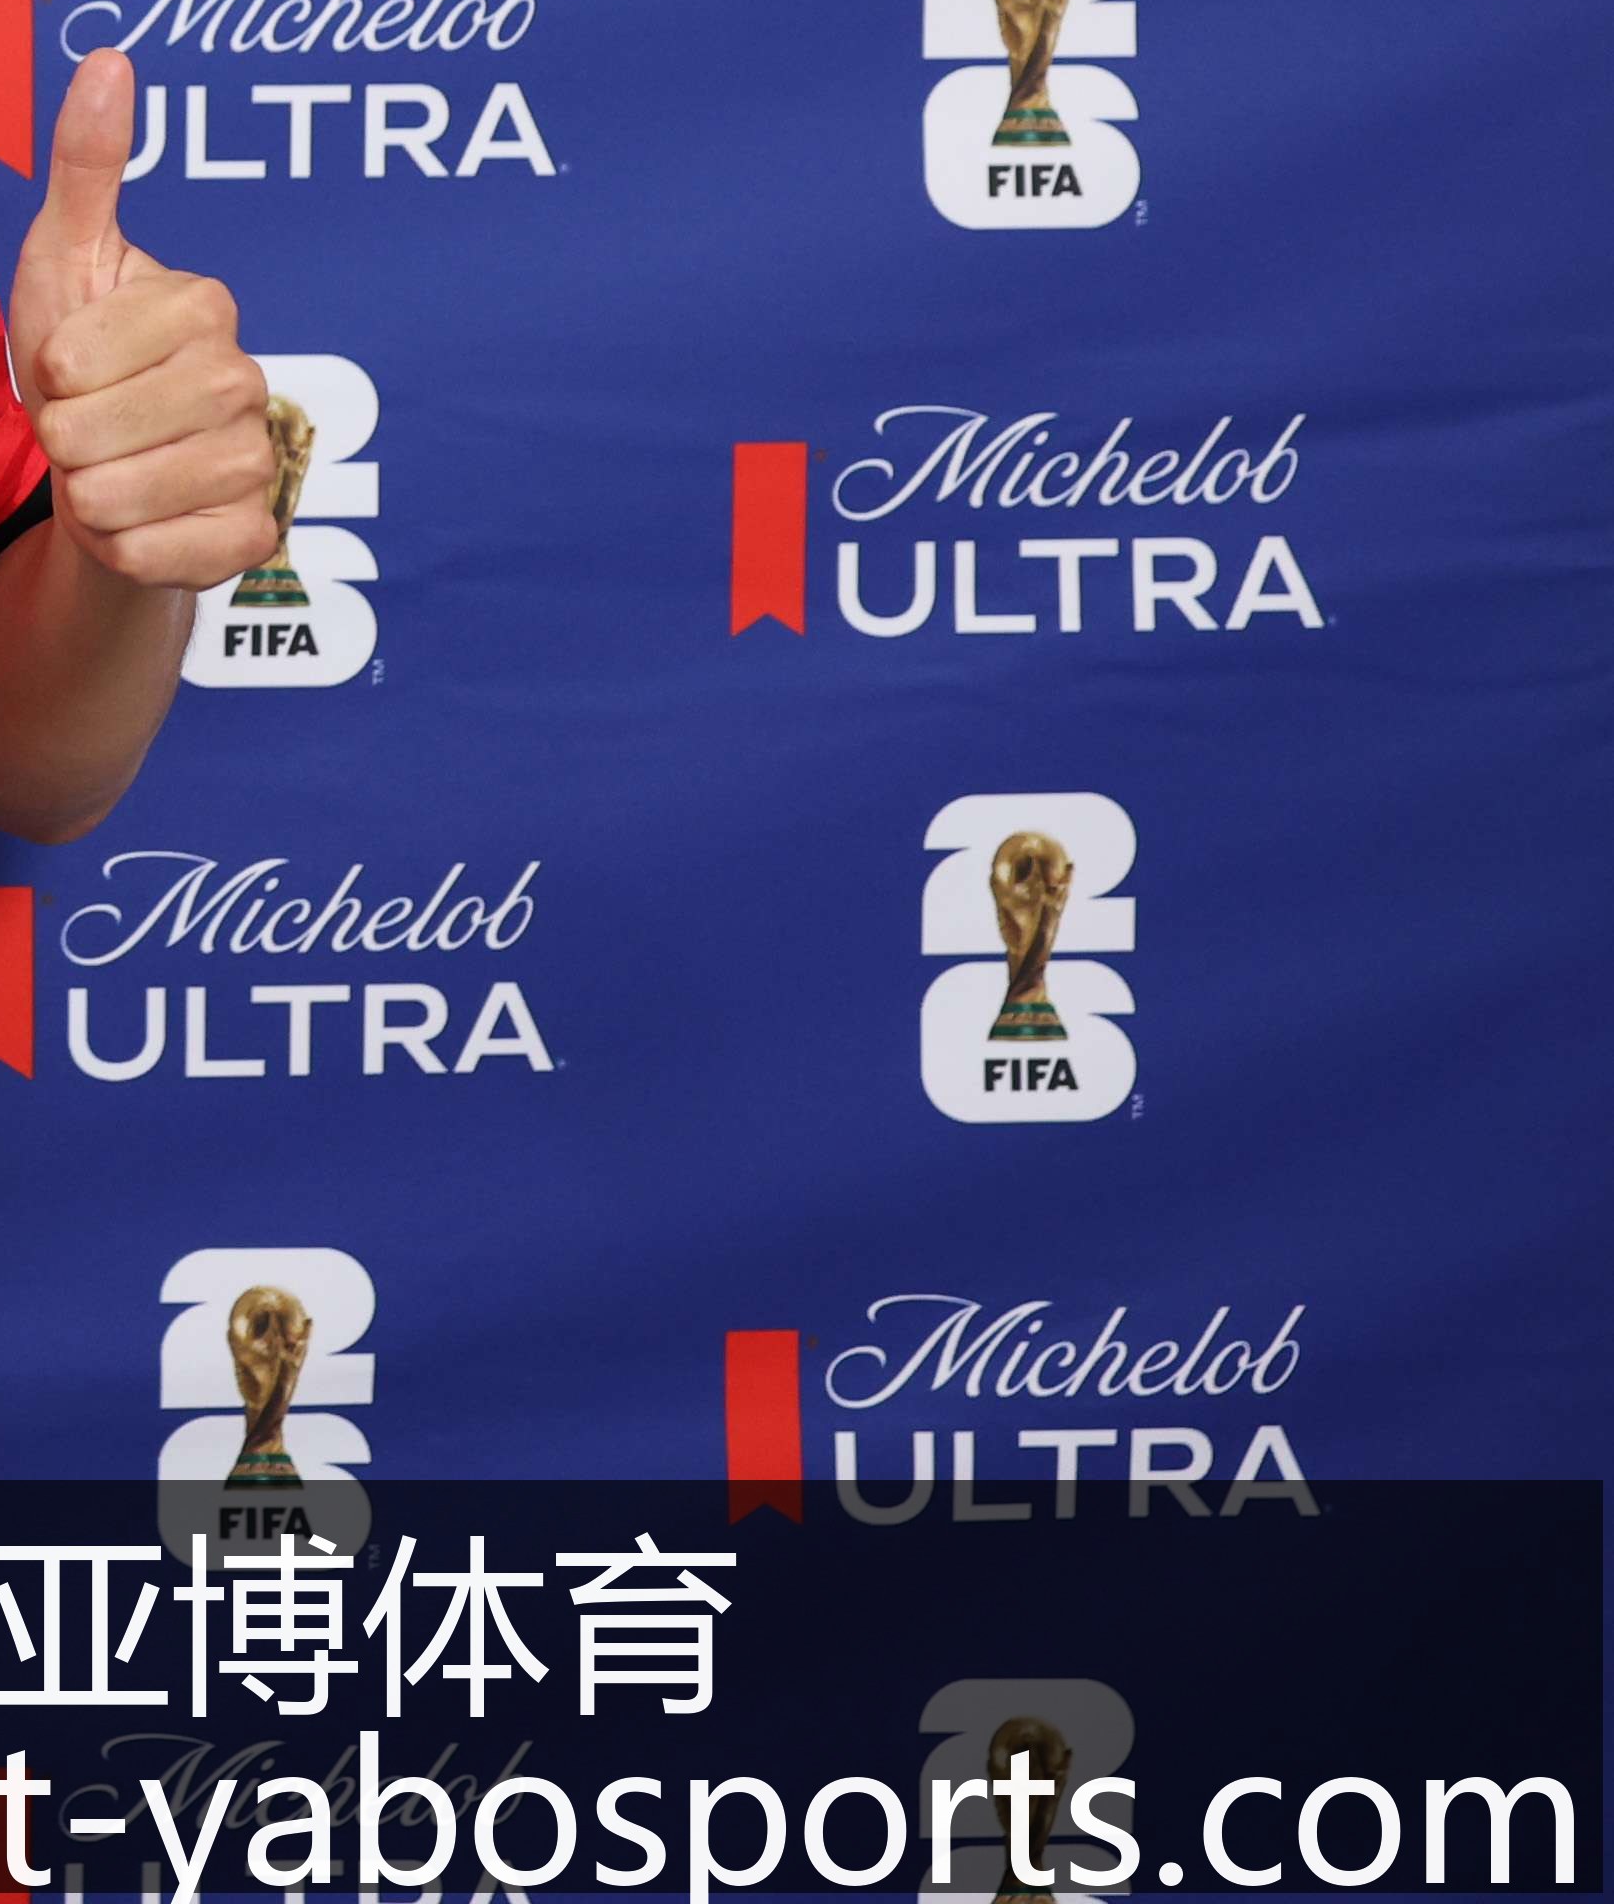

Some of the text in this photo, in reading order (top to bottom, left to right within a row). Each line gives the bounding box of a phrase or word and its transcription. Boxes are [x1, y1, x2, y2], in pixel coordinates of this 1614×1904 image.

[988, 164, 1082, 198] FIFA
[832, 405, 1305, 521] Michelob
[838, 536, 1324, 637] ULTRA
[224, 623, 319, 657] FIFA
[61, 851, 540, 966] Michelob
[68, 982, 554, 1081] ULTRA
[984, 1058, 1079, 1092] FIFA
[825, 1294, 1305, 1408] Michelob
[218, 1506, 314, 1540] FIFA
[834, 1424, 1322, 1525] ULTRA
